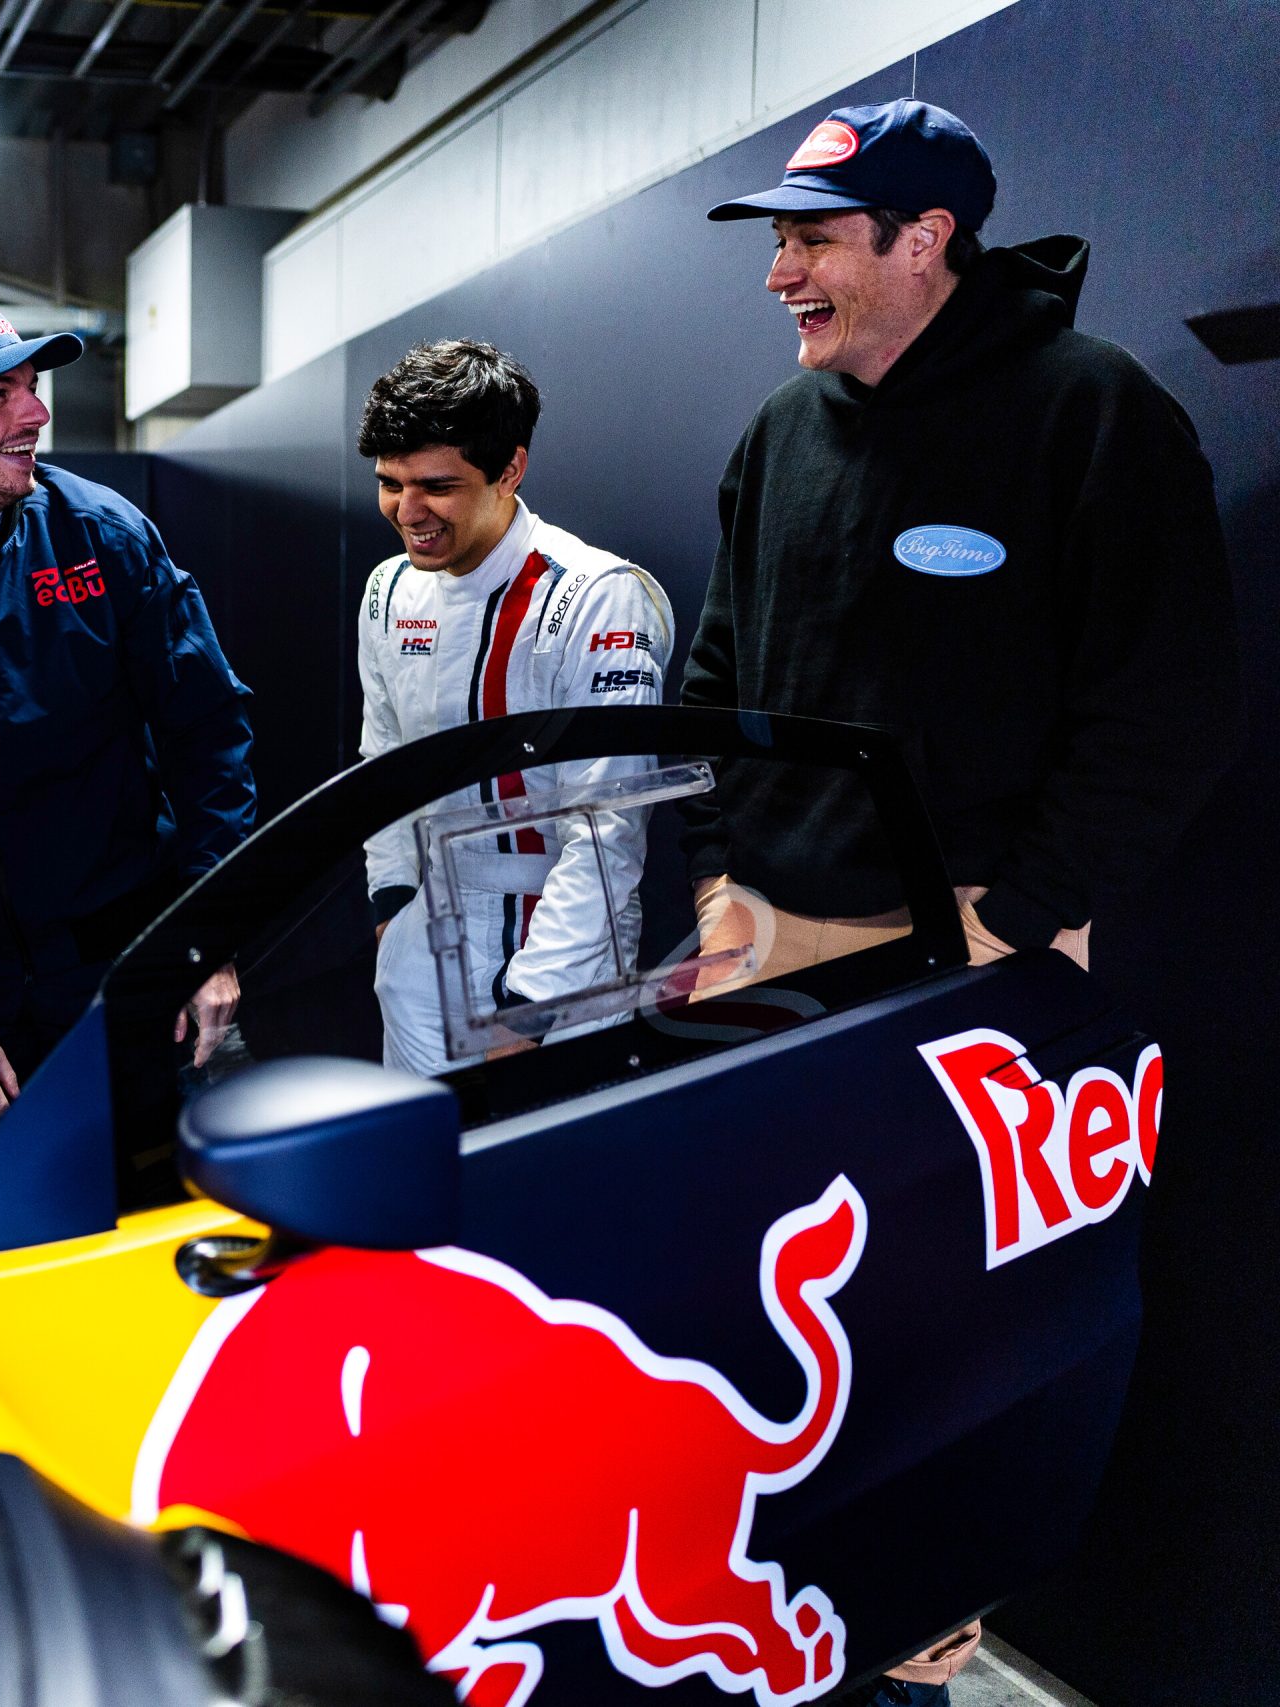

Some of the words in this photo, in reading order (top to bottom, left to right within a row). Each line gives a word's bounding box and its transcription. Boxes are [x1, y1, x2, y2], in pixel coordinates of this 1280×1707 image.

[548, 574, 588, 636] sparco
[395, 619, 438, 629] HONDA
[590, 685, 627, 693] SUZUKA
